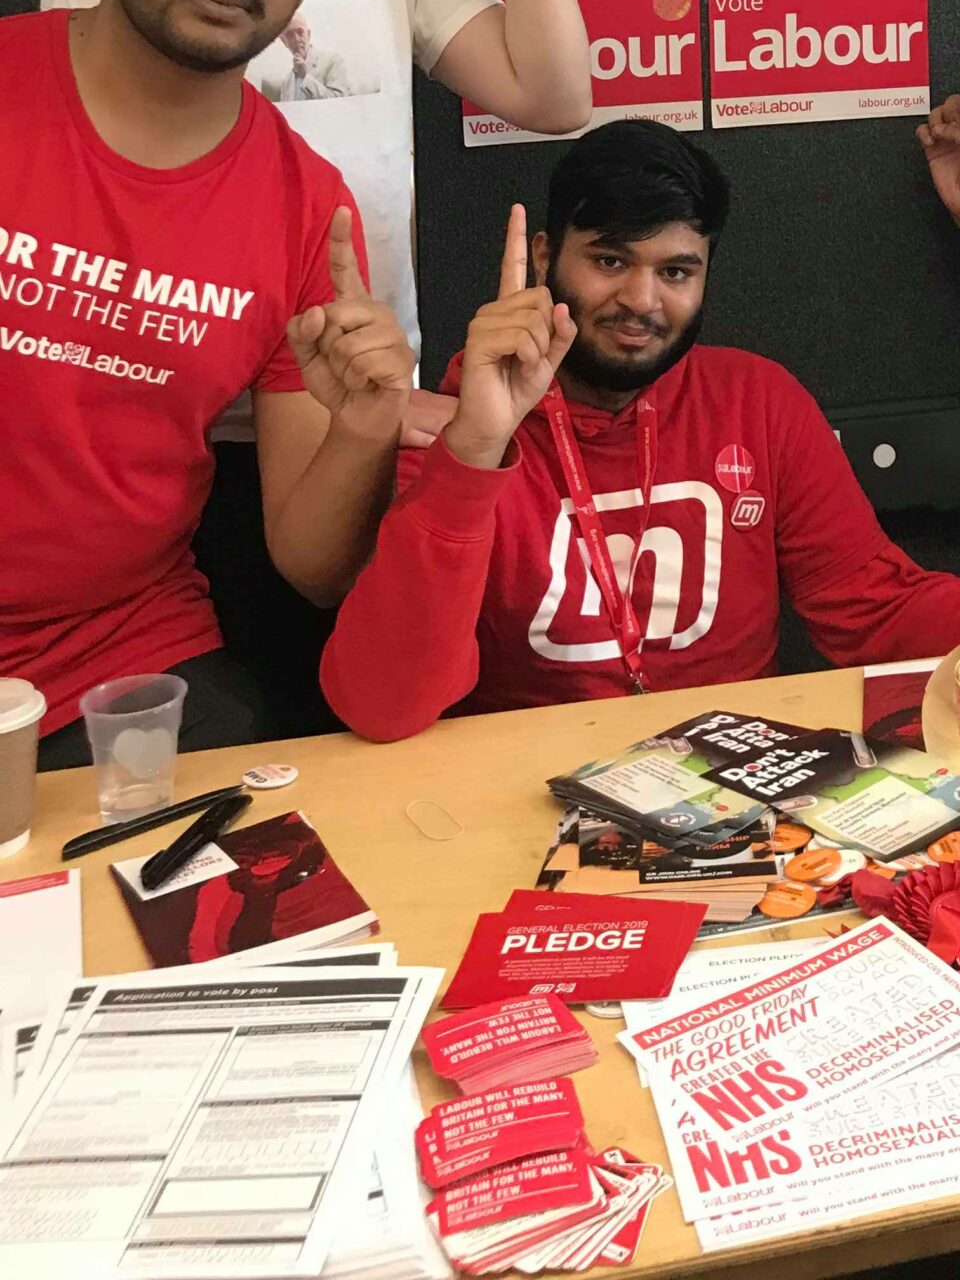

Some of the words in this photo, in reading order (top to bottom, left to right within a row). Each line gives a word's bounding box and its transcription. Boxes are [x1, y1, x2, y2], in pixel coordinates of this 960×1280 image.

[713, 13, 924, 73] Labour
[716, 103, 750, 117] Vote
[762, 99, 815, 114] Labour
[858, 95, 926, 108] labour.org.uk
[50, 242, 129, 294] THE
[131, 268, 256, 321] MANY
[0, 273, 67, 312] NOT
[72, 289, 133, 332] THE
[138, 309, 209, 348] FEW
[0, 326, 64, 363] Vote
[80, 346, 176, 386] Labour
[701, 731, 751, 754] Iran
[718, 748, 797, 782] Don't
[741, 748, 831, 790] Attack
[755, 769, 817, 797] Iran
[506, 924, 560, 935] GENERAL
[563, 921, 620, 933] ELECTION
[622, 919, 649, 930] 2019
[500, 928, 646, 955] PLEDGE
[709, 956, 766, 967] ELECTION
[113, 990, 185, 1003] Application
[185, 990, 201, 999] to
[232, 987, 249, 998] by
[250, 985, 280, 998] post
[642, 999, 744, 1045] NATIONAL
[743, 958, 828, 1002] MINIMUM
[826, 928, 885, 961] WAGE
[679, 976, 738, 993] ELECTION
[511, 1009, 531, 1021] THE
[517, 1015, 558, 1031] BRITAIN
[532, 1007, 553, 1018] NOT
[650, 1038, 690, 1064] THE
[690, 1013, 746, 1047] GOOD
[752, 983, 808, 1021] FRIDAY
[475, 1031, 496, 1044] THE
[495, 1024, 517, 1036] FOR
[497, 1033, 521, 1047] WILL
[521, 1024, 562, 1041] LABOUR
[670, 995, 820, 1082] AGREEMENT
[805, 998, 955, 1081] DECRIMINALISED
[450, 1041, 494, 1064] REBUILD
[680, 1058, 743, 1096] CREATED
[742, 1047, 773, 1067] THE
[823, 1090, 843, 1105] you
[843, 1079, 869, 1094] stand
[869, 1067, 891, 1081] with
[890, 1059, 906, 1071] the
[907, 1045, 934, 1063] many
[934, 1035, 951, 1048] and
[439, 1096, 483, 1117] LABOUR
[485, 1089, 511, 1102] WILL
[513, 1081, 558, 1097] REBUILD
[690, 1059, 809, 1132] NHS
[441, 1107, 485, 1129] BRITAIN
[487, 1100, 509, 1114] FOR
[510, 1096, 531, 1108] THE
[532, 1091, 568, 1105] MANY.
[443, 1126, 466, 1141] NOT
[469, 1119, 490, 1133] THE
[812, 1175, 832, 1187] you
[834, 1167, 865, 1180] stand
[867, 1159, 893, 1171] with
[894, 1156, 913, 1166] the
[915, 1149, 945, 1163] many
